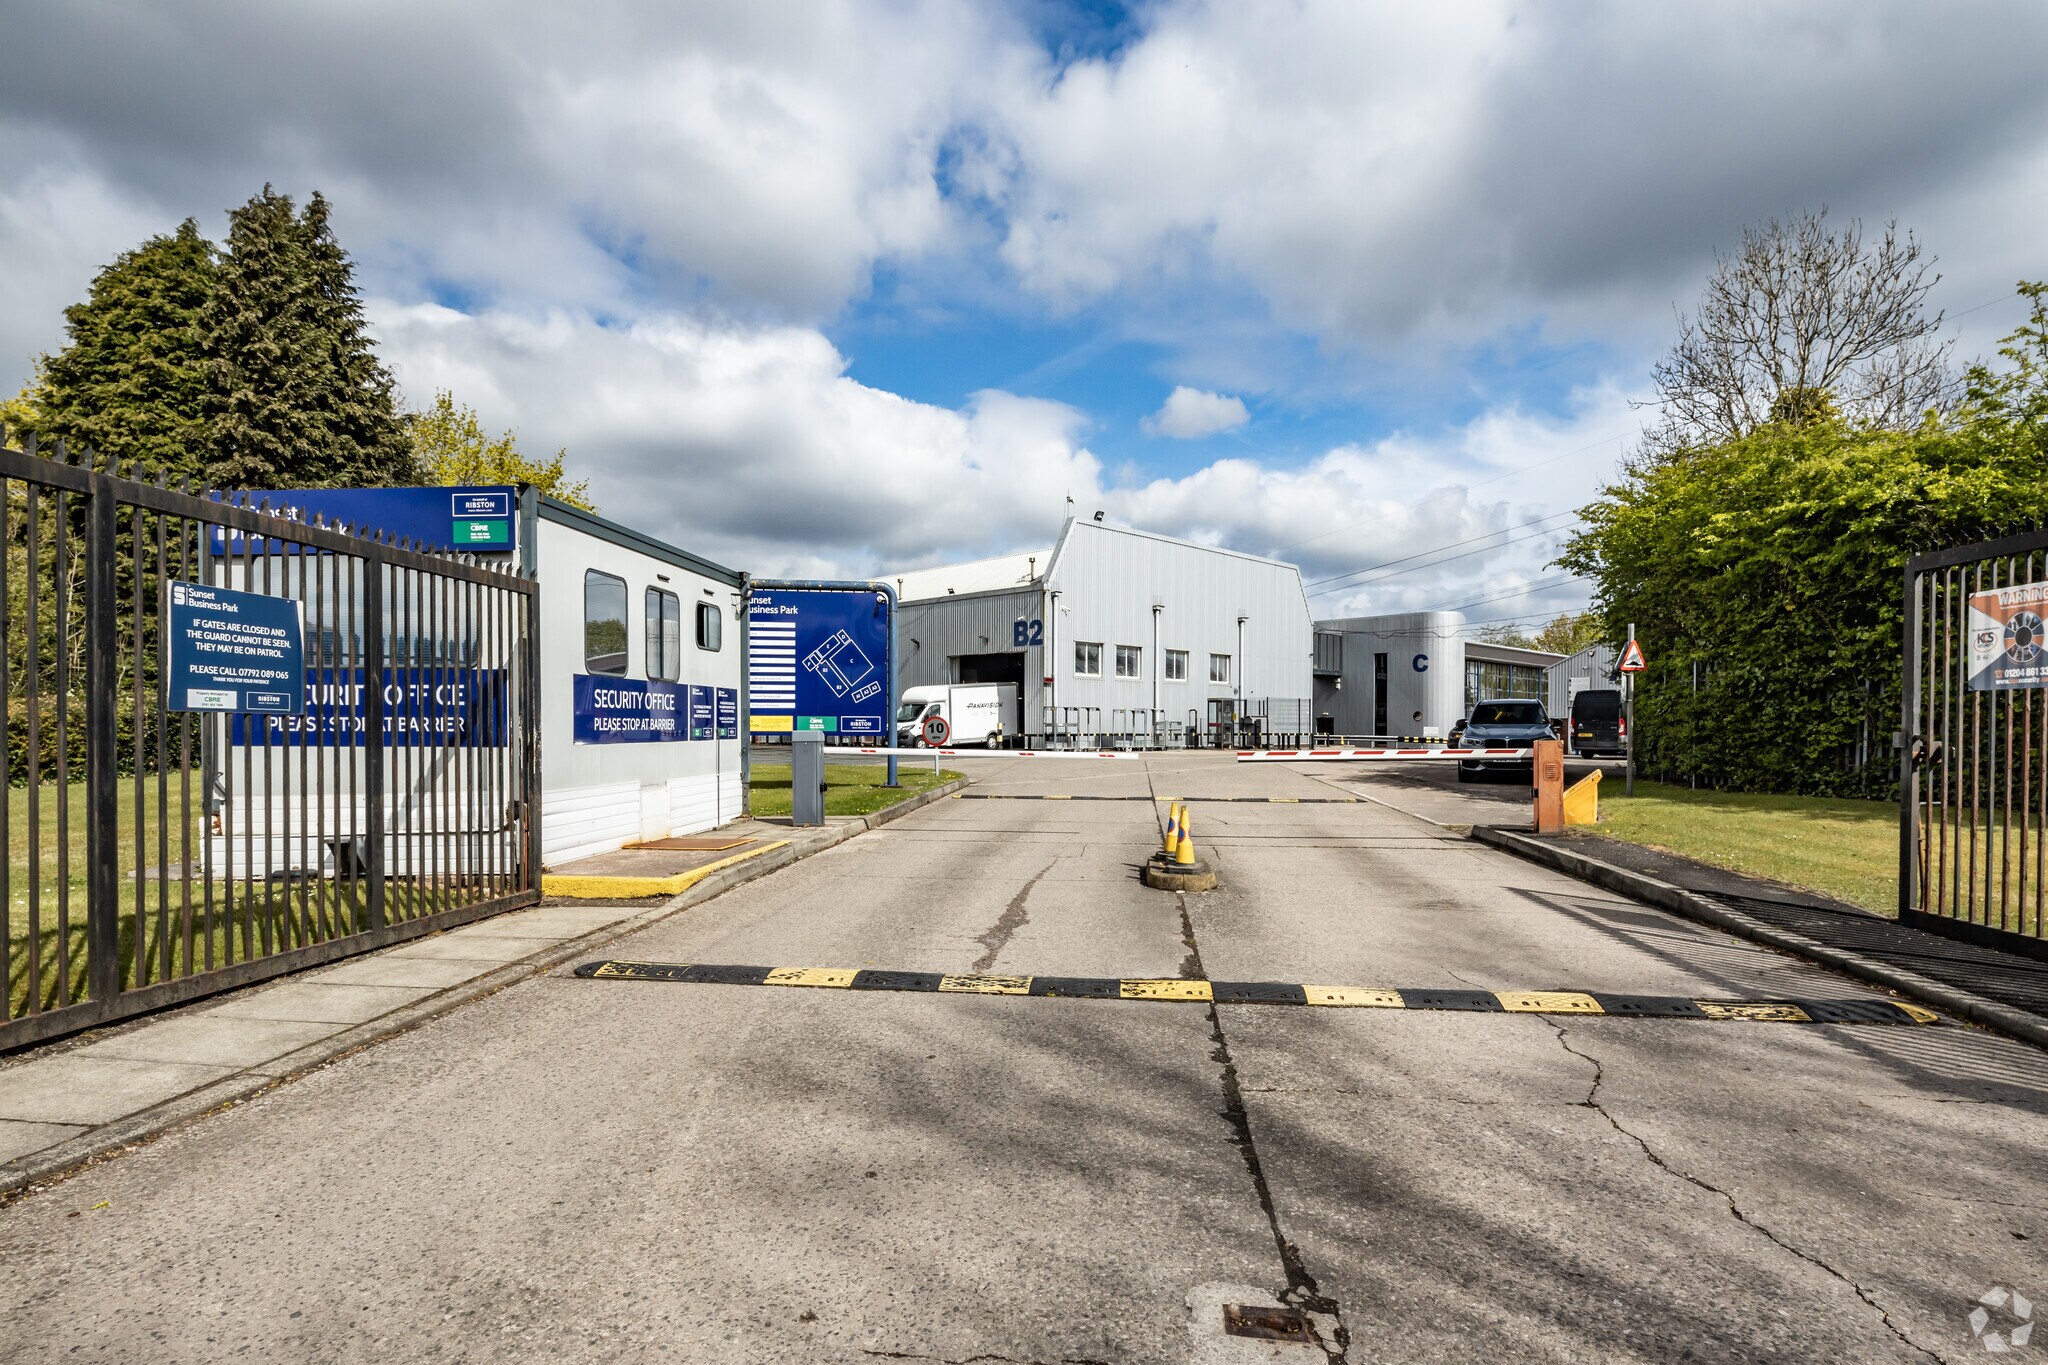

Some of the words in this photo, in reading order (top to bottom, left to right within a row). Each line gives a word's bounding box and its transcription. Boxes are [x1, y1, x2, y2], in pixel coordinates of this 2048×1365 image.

[188, 588, 215, 600] Sunset
[188, 598, 221, 610] Business
[222, 604, 238, 613] Park
[780, 605, 798, 614] Park
[193, 619, 201, 627] IF
[202, 620, 226, 630] GATES
[226, 623, 241, 632] ARE
[242, 624, 270, 635] CLOSED
[270, 628, 286, 637] AND
[1014, 620, 1042, 646] B2
[186, 630, 202, 639] THE
[204, 631, 230, 641] GUARD
[232, 634, 262, 645] CANNOT
[1978, 632, 1994, 644] KCS
[195, 642, 216, 652] THEY
[217, 645, 234, 654] MAY
[234, 646, 244, 654] BE
[245, 647, 256, 656] ON
[1413, 654, 1428, 672] C
[190, 664, 218, 674] PLEASE
[219, 667, 237, 676] CALL
[238, 668, 260, 677] 07792
[260, 670, 274, 678] 089
[275, 671, 289, 679] 065
[2005, 668, 2025, 677] 01204
[2026, 668, 2039, 676] 861
[594, 689, 643, 709] SECURITY
[645, 693, 675, 710] OFFICE
[594, 718, 621, 730] PLEASE
[622, 718, 640, 730] STOP
[641, 718, 649, 730] AT
[650, 718, 674, 730] BARRIER
[928, 723, 944, 733] 10
